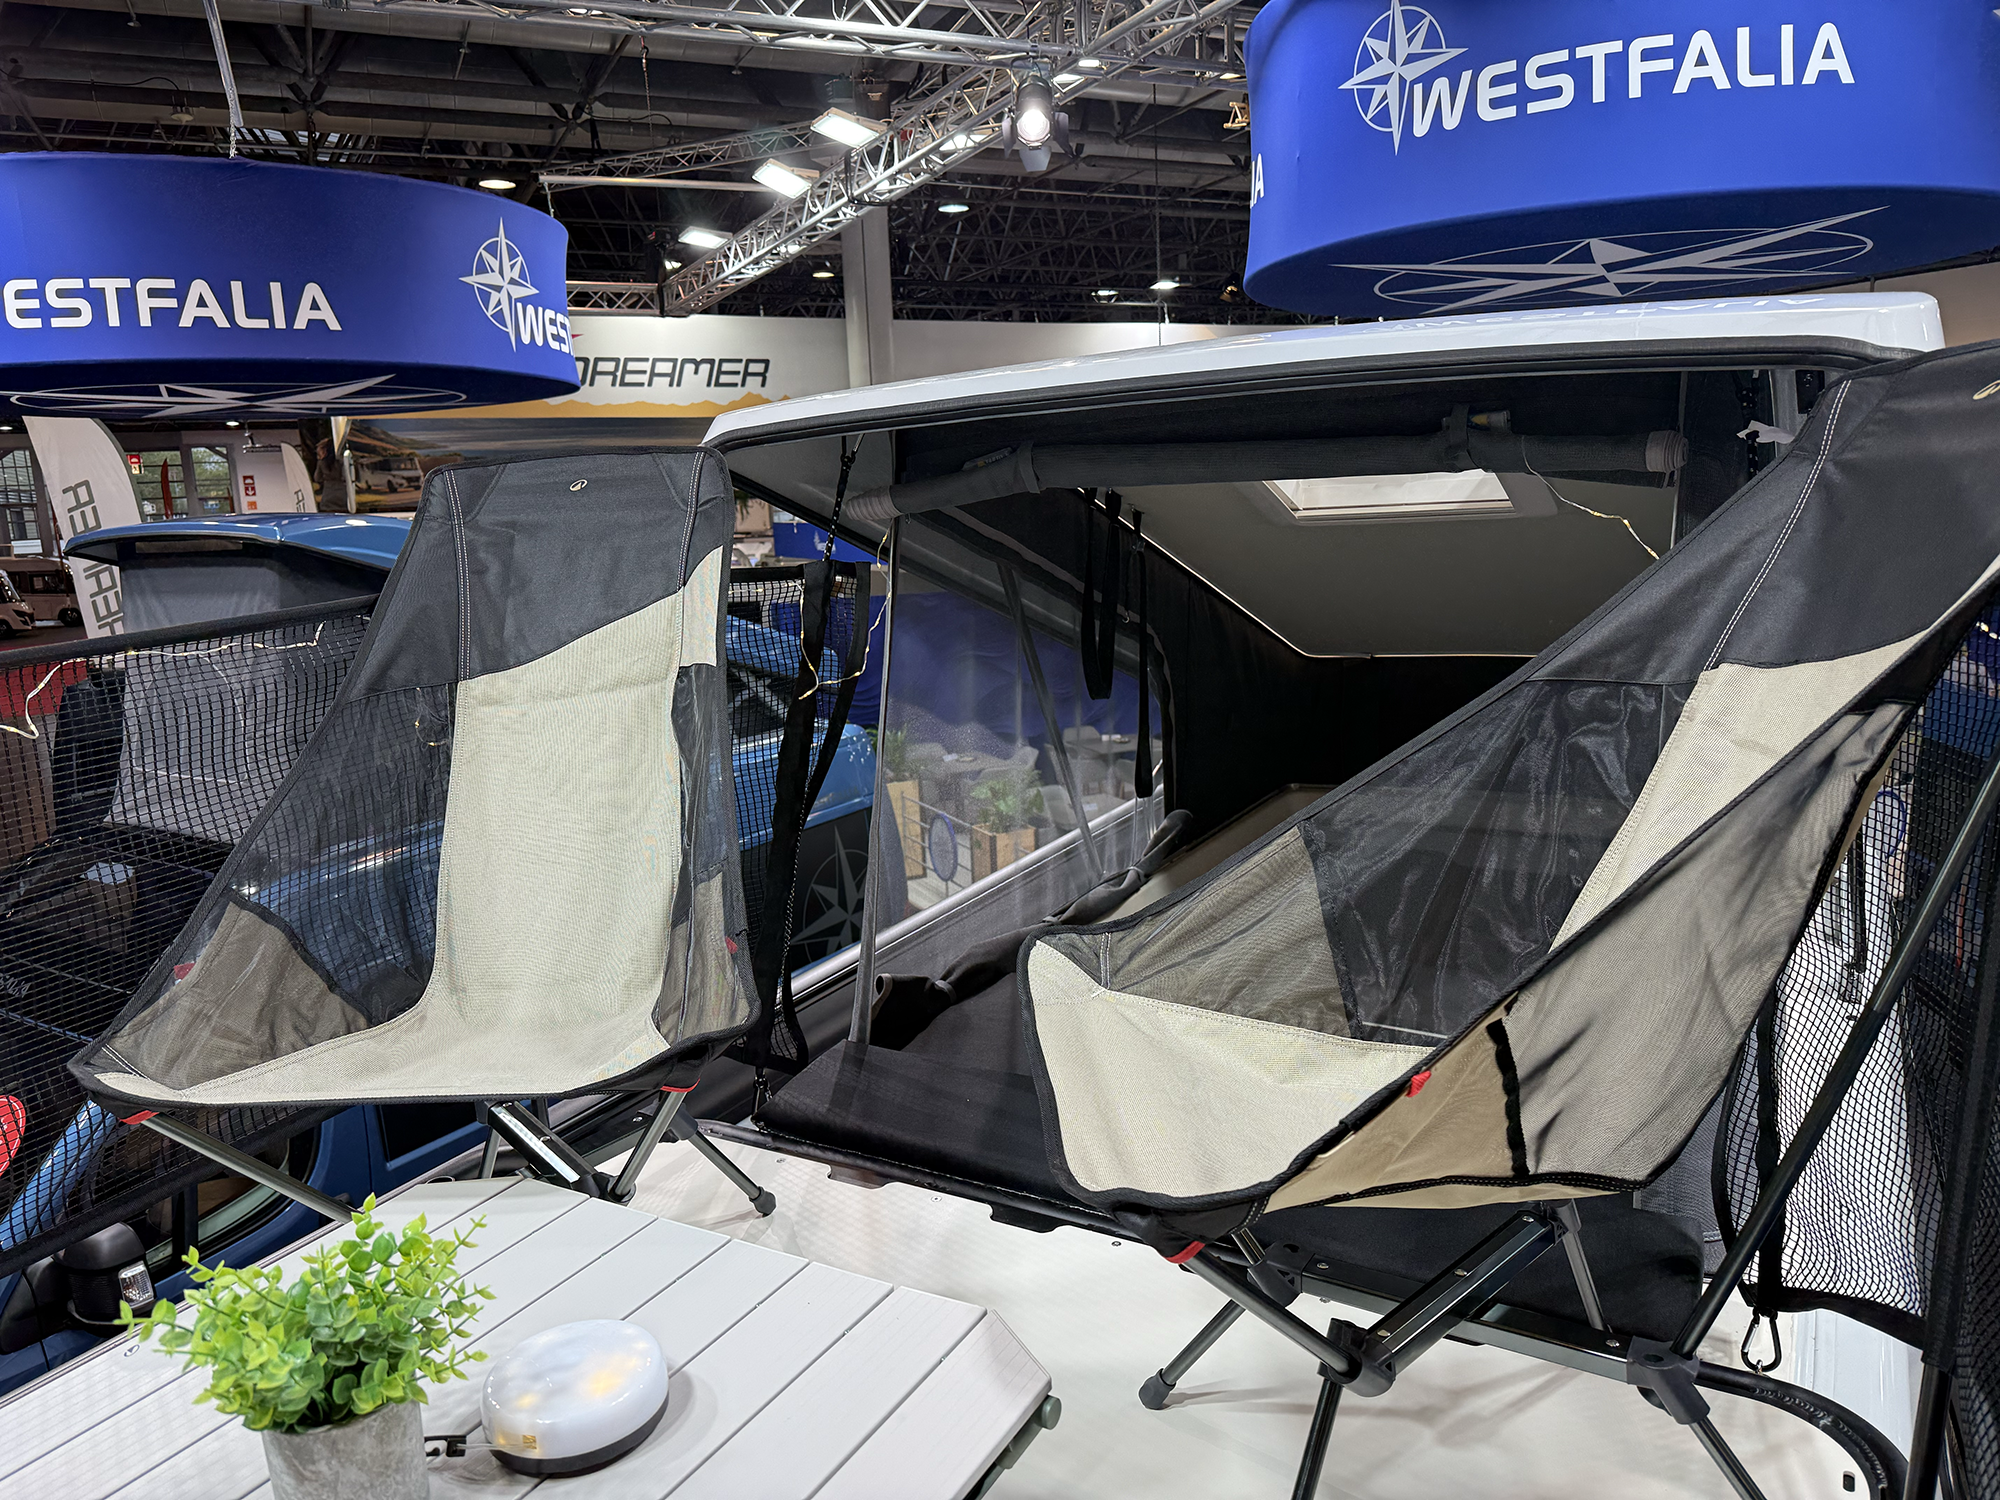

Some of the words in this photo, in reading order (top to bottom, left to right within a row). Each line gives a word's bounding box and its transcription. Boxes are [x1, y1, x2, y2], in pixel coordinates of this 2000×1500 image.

[1412, 22, 1856, 138] WESTFALIA
[3, 278, 342, 331] ESTFALIA
[574, 356, 770, 388] DREAMER
